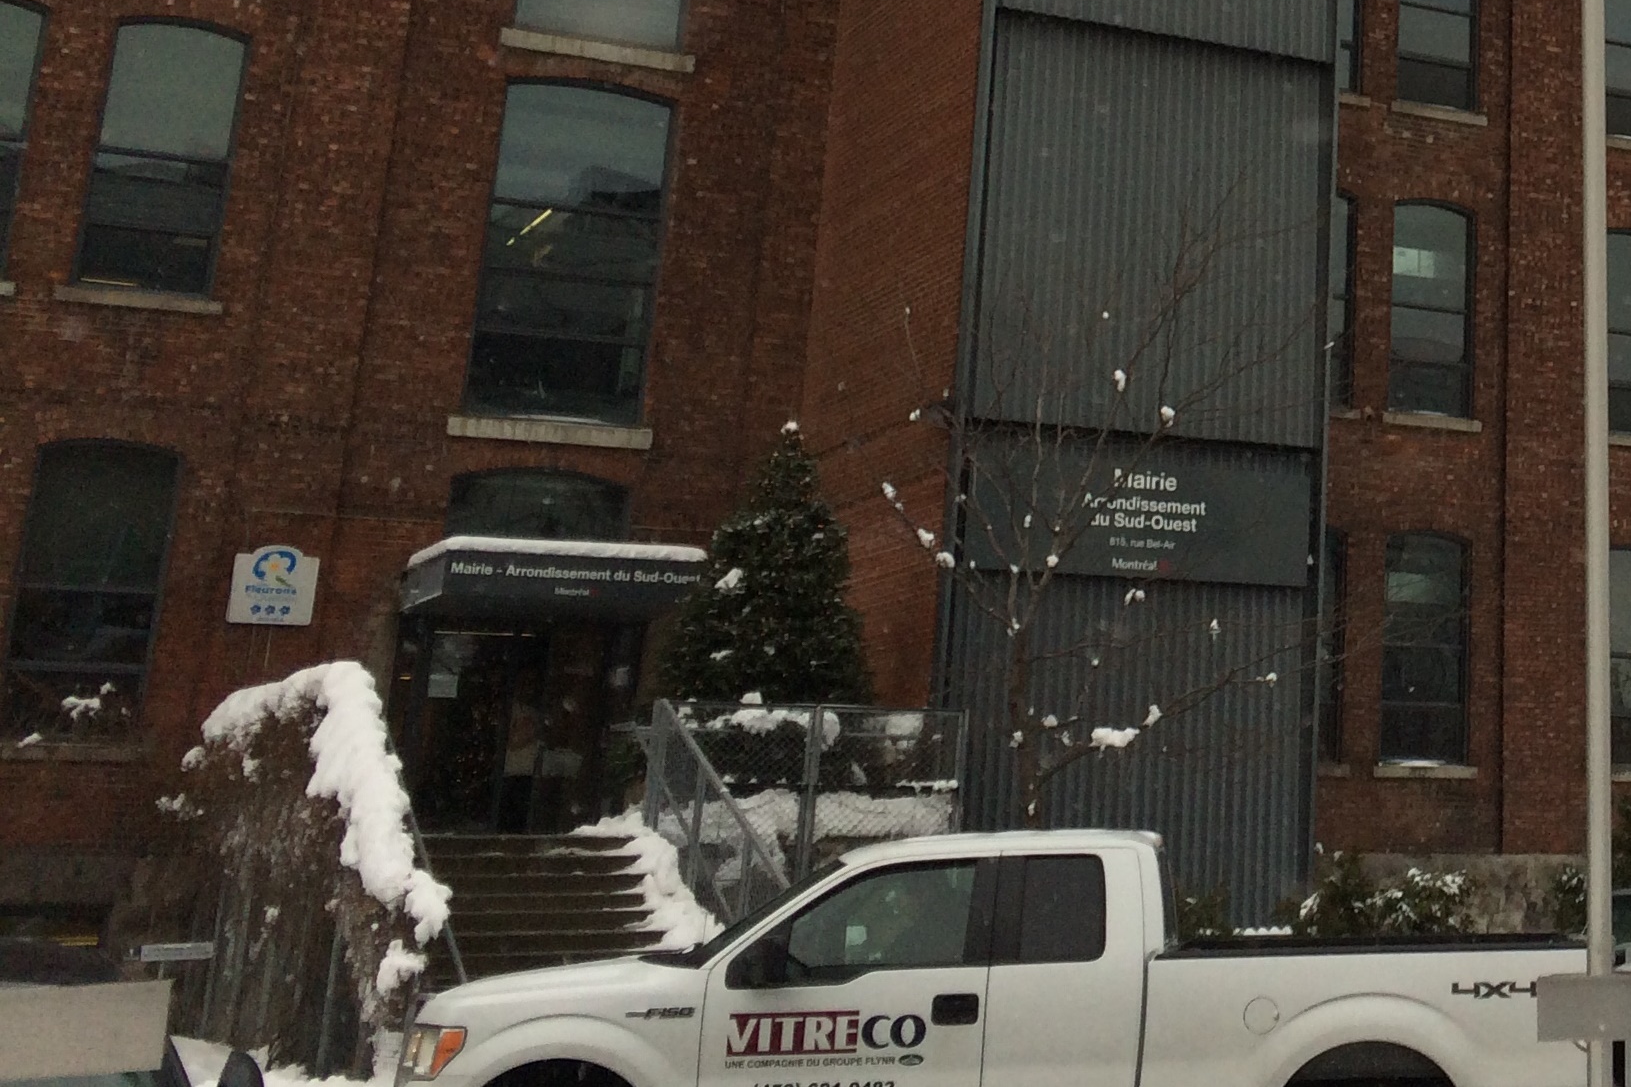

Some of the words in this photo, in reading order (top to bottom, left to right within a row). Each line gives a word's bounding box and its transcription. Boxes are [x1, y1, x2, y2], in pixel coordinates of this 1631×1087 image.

[1114, 512, 1198, 533] Sud-Ouest
[450, 562, 494, 576] Mairie
[505, 564, 611, 582] Arrondissement
[613, 571, 631, 582] du
[726, 1011, 927, 1057] VITRECO
[724, 1058, 746, 1070] UNE
[746, 1056, 804, 1069] COMPAGNIE
[806, 1056, 820, 1067] DU
[822, 1056, 863, 1067] GROUPE
